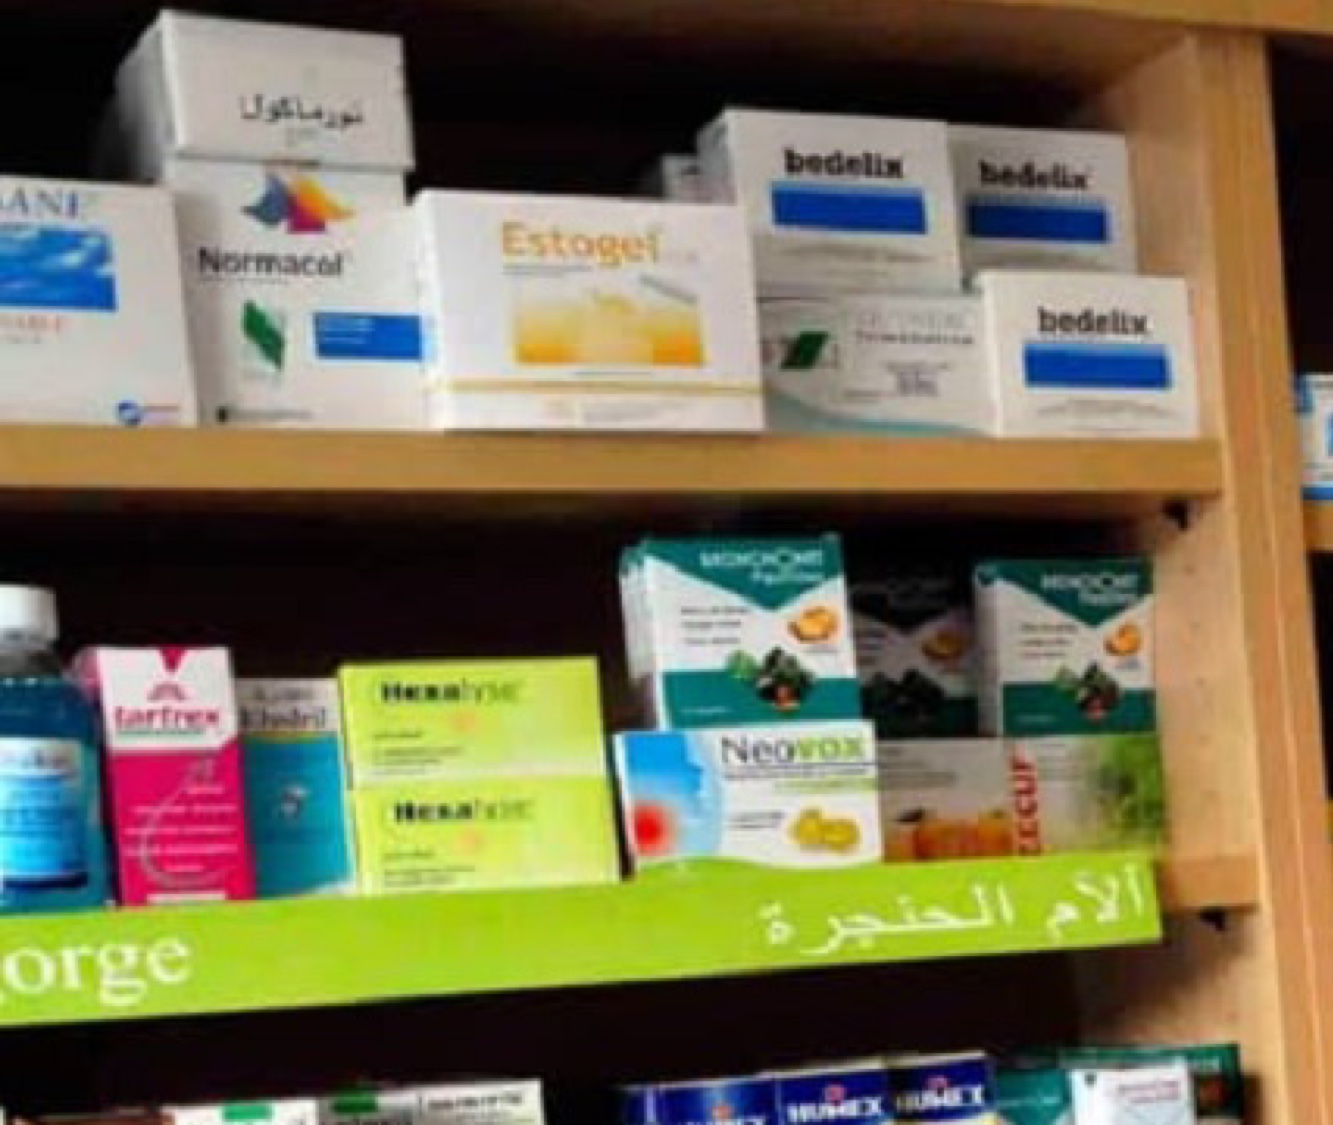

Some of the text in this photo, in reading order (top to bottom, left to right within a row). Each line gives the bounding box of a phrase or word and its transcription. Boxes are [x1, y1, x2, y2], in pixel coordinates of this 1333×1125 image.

[784, 149, 904, 180] bedelix
[978, 160, 1089, 192] bedelix
[502, 222, 662, 268] Estogel
[198, 247, 343, 278] Normacol
[1037, 305, 1151, 337] bedelix
[719, 735, 865, 766] Neovox
[0, 936, 190, 1008] orge
